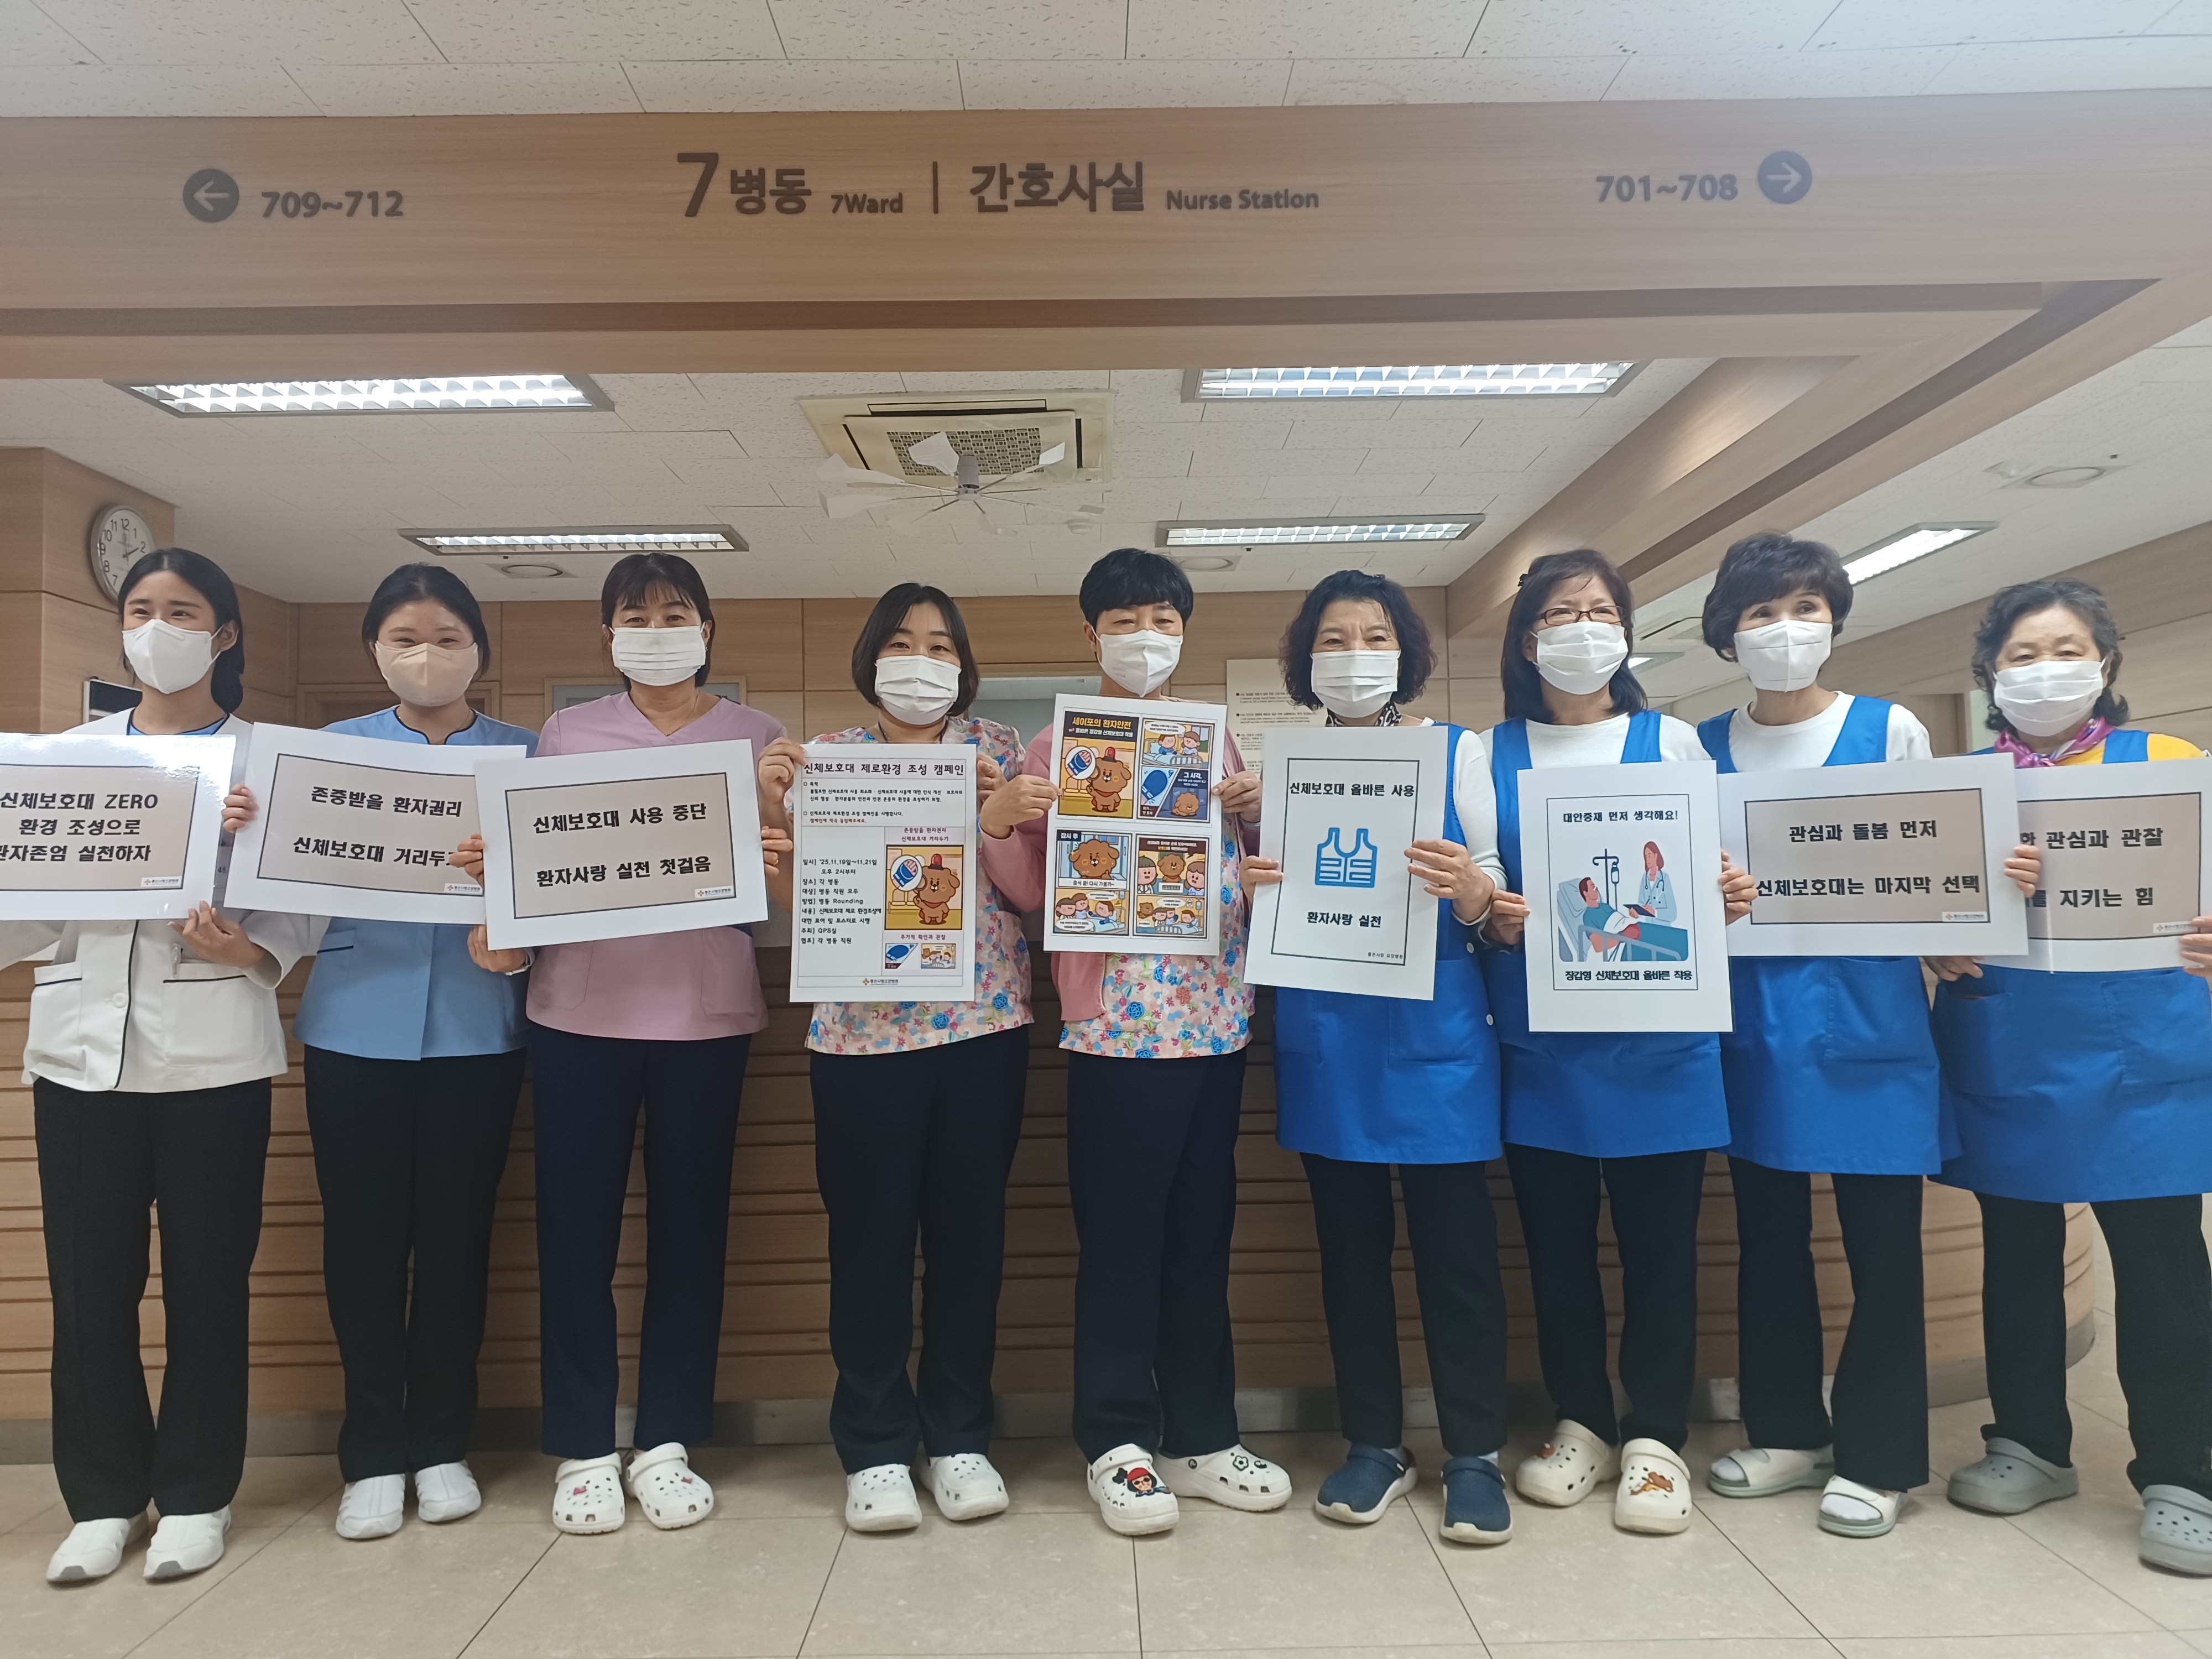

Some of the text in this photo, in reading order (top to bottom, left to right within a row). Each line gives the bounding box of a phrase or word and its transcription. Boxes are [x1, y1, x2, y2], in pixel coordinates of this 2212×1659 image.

[831, 192, 902, 213] 7Ward
[969, 161, 1144, 213] 간호사실
[1166, 190, 1232, 210] Nurse
[1238, 189, 1319, 210] Station
[1595, 174, 1738, 203] 701~708
[262, 190, 403, 218] 709~712
[111, 519, 117, 532] 11
[121, 518, 129, 531] 12
[103, 529, 112, 541] 10
[100, 542, 106, 555] 9
[140, 541, 145, 554] 2
[104, 560, 109, 572] 8
[112, 575, 118, 587] 7
[1072, 717, 1131, 729] 세이포의 환자안전
[804, 763, 963, 775] 신체보호대 제로환경 조성 캠페인
[1290, 782, 1414, 797] 신체보호대 올바른 사용
[0, 792, 158, 810] 신체보호대 ZERO
[311, 786, 461, 817] 존중받을 환자권리
[533, 803, 706, 833] 신체보호대 사용 중단
[1563, 810, 1678, 823] 대안중재 먼저 생각해요!
[19, 819, 140, 836] 환경 조성으로
[1790, 821, 1937, 842] 관심과 돌봄 먼저
[2047, 830, 2109, 849] 관심과
[2121, 828, 2163, 847] 관찰
[79, 845, 151, 862] 실천하자
[294, 837, 455, 868] 신체보호대 거리두
[537, 856, 711, 887] 환자사랑 실천 첫걸음
[1756, 875, 1979, 896] 신체보호대는 마지막 선택
[2060, 889, 2122, 907] 지키는
[2136, 888, 2152, 905] 힘
[1307, 911, 1381, 928] 환자사랑 실천
[1566, 970, 1692, 981] 장갑형 신체보호대 올바른 착용
